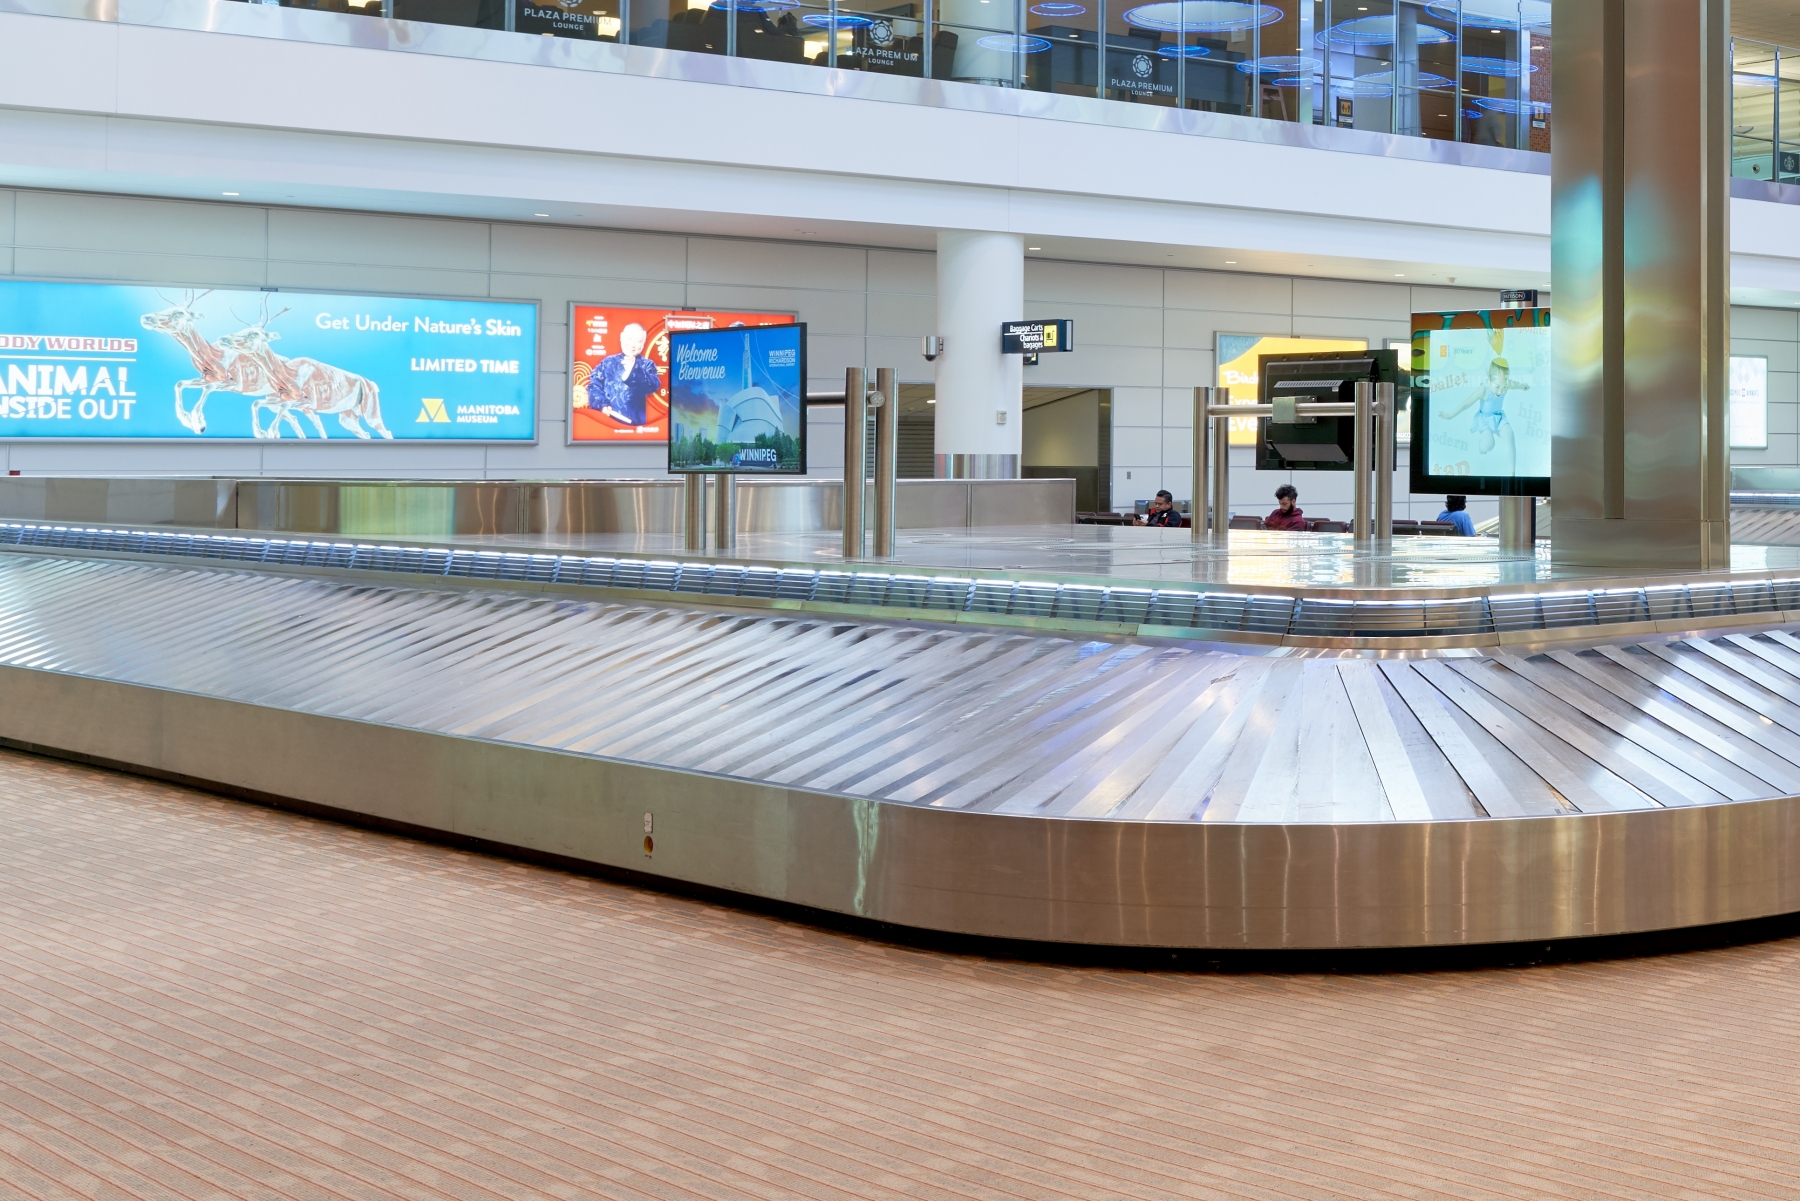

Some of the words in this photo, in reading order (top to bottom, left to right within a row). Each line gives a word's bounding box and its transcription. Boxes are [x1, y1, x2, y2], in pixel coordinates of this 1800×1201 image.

[524, 8, 560, 20] PLAZA
[562, 12, 612, 26] PREMIUM
[553, 22, 584, 30] LOUNGE
[868, 58, 894, 66] LOUNGE
[876, 48, 918, 62] PREMUM
[1111, 78, 1136, 88] PLAZA
[1138, 82, 1173, 93] PREMIUM
[315, 312, 350, 330] Get
[355, 314, 409, 332] Under
[414, 316, 482, 336] Nature's
[485, 318, 522, 337] Skin
[1010, 324, 1030, 334] Baggage
[1030, 324, 1044, 332] Carts
[46, 337, 136, 352] WORLDS
[1020, 334, 1040, 342] Chariots
[676, 343, 718, 364] Welcome
[1022, 342, 1044, 350] bagages
[410, 358, 478, 373] LIMITED
[480, 359, 520, 374] TIME
[678, 360, 726, 380] Bienvenue
[1430, 372, 1468, 393] ballet
[78, 398, 137, 420] OUT
[456, 404, 520, 416] MANITOBA
[1518, 402, 1543, 426] hip
[456, 415, 498, 424] MUSEUM
[1430, 432, 1468, 452] odern
[740, 448, 776, 462] WINNIPEG
